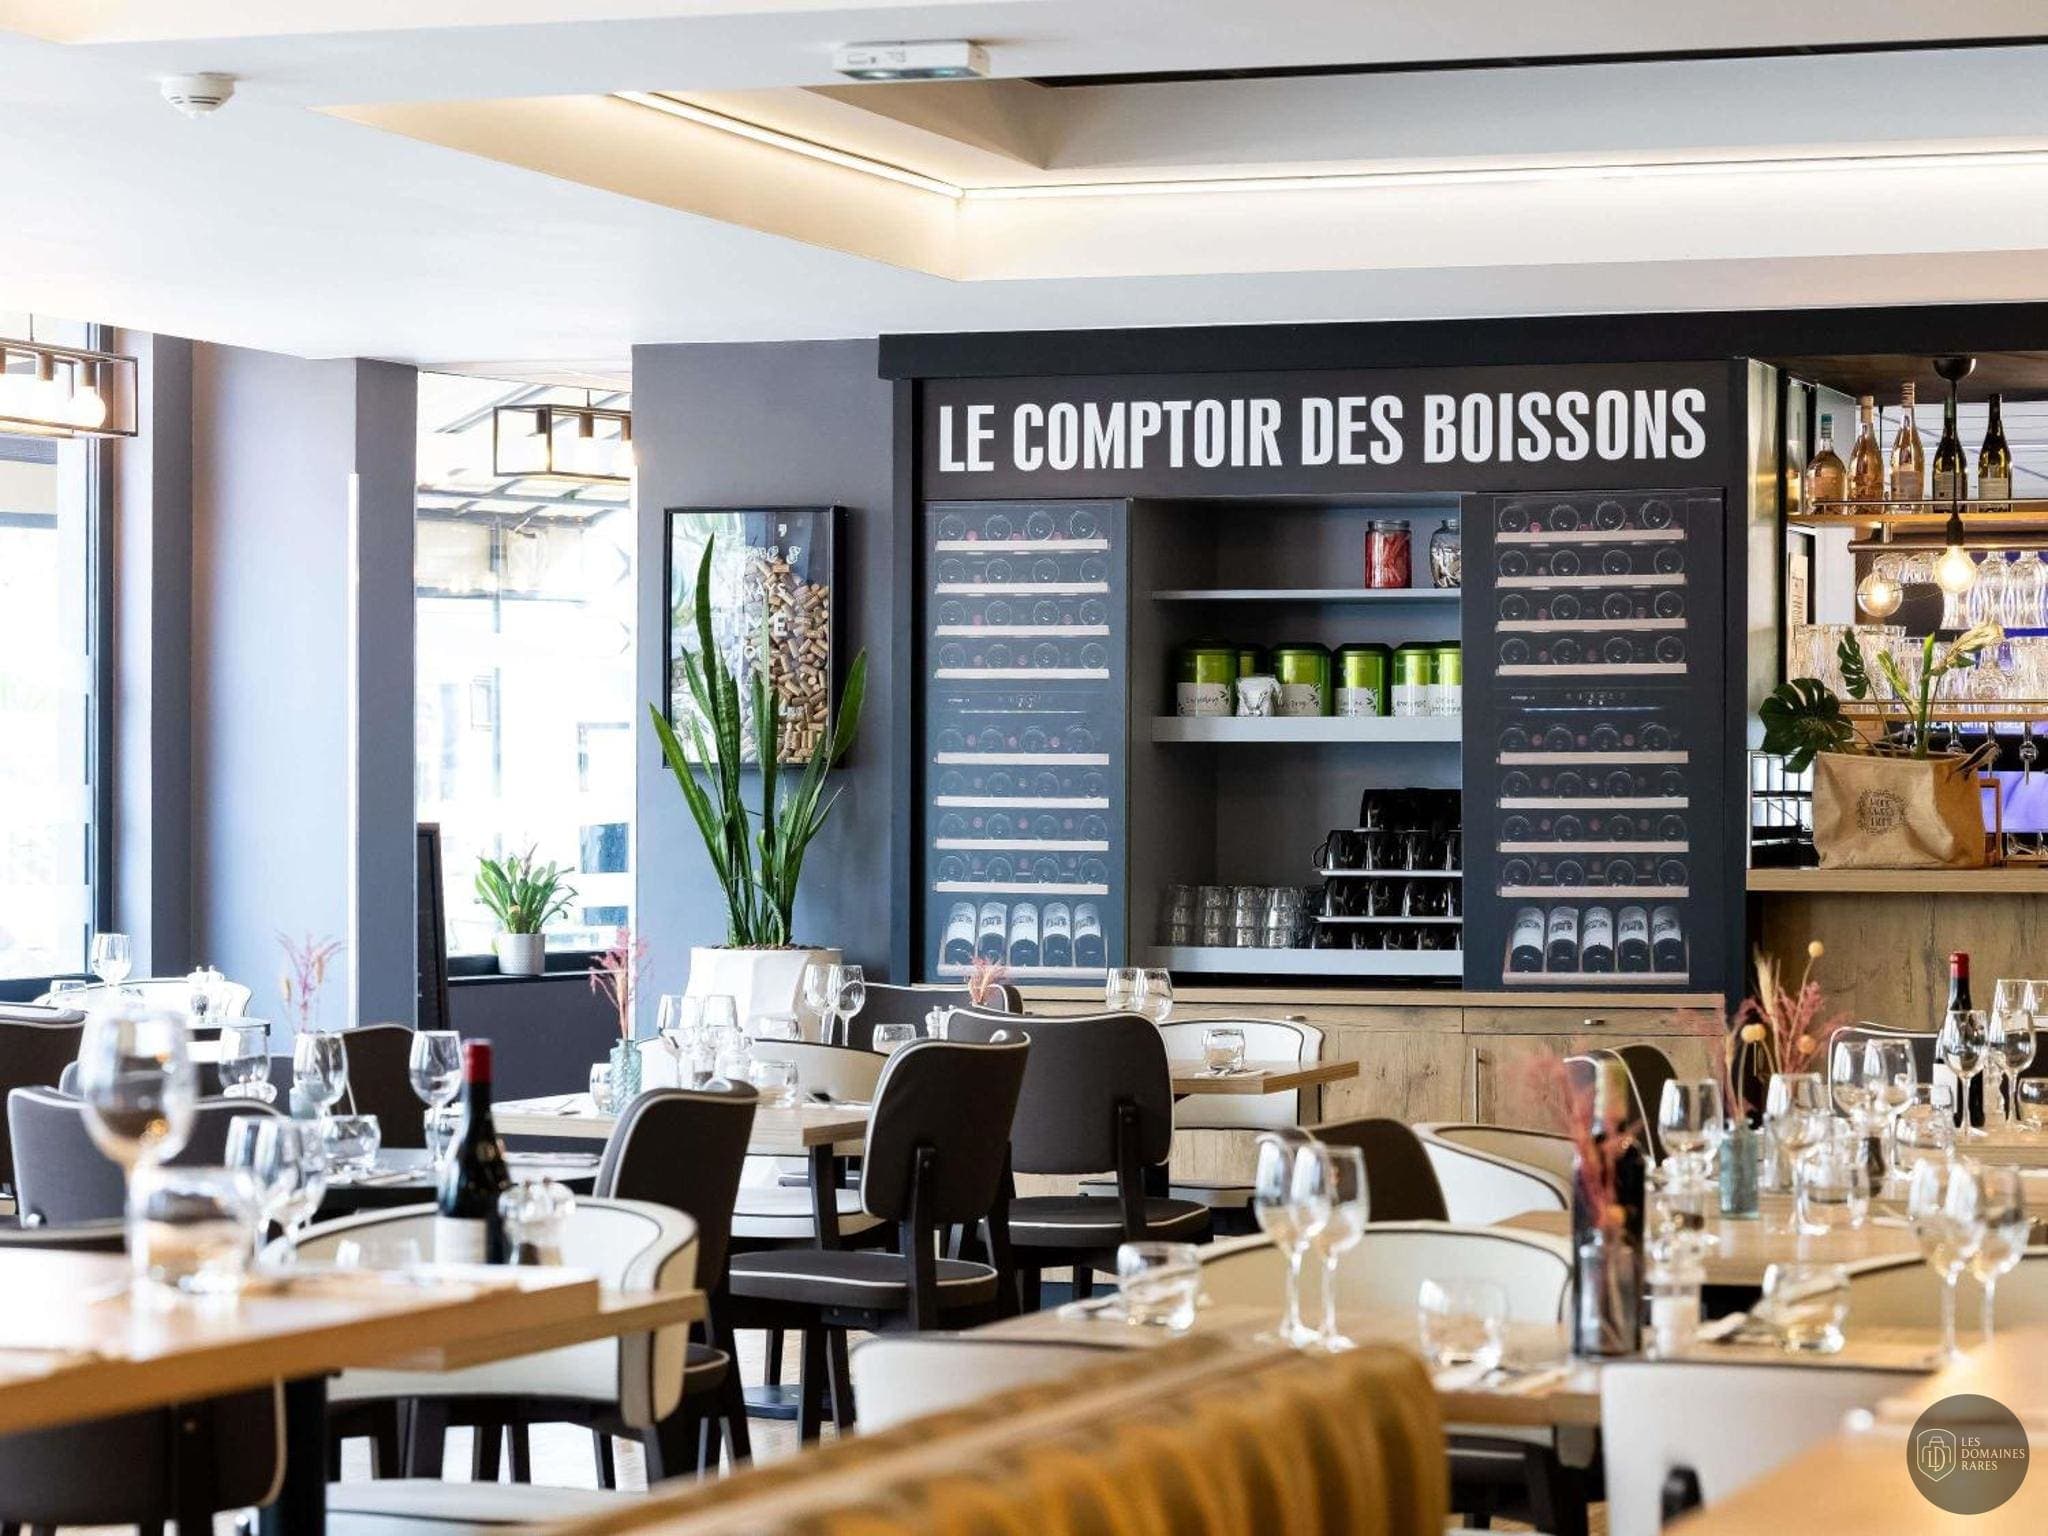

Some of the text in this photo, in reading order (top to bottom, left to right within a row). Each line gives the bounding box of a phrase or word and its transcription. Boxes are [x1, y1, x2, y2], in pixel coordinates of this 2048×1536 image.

[939, 388, 1706, 472] LE COMPTOIR DES BOISSONS
